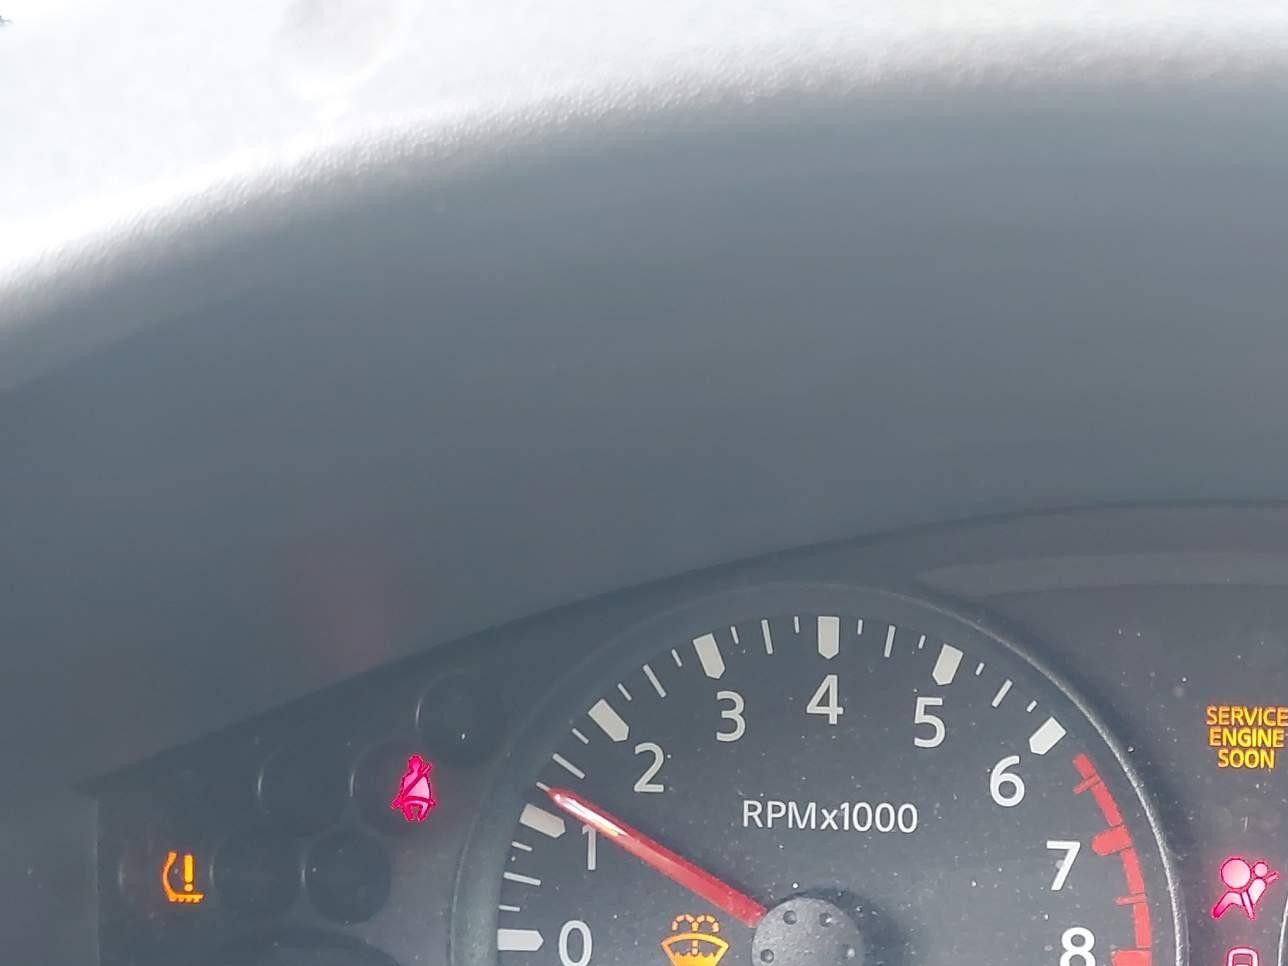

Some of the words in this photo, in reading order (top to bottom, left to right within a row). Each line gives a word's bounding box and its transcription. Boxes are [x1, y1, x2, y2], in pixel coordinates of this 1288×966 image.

[716, 691, 746, 741] 3
[807, 675, 843, 724] 4
[914, 697, 945, 747] 5
[1206, 706, 1288, 729] SERVICE
[1209, 728, 1285, 749] ENGINE
[1217, 747, 1275, 770] SOON
[634, 743, 664, 793] 2
[990, 756, 1024, 806] 6
[742, 801, 918, 833] RPMx1000
[581, 824, 597, 871] 1
[1047, 841, 1080, 890] 7
